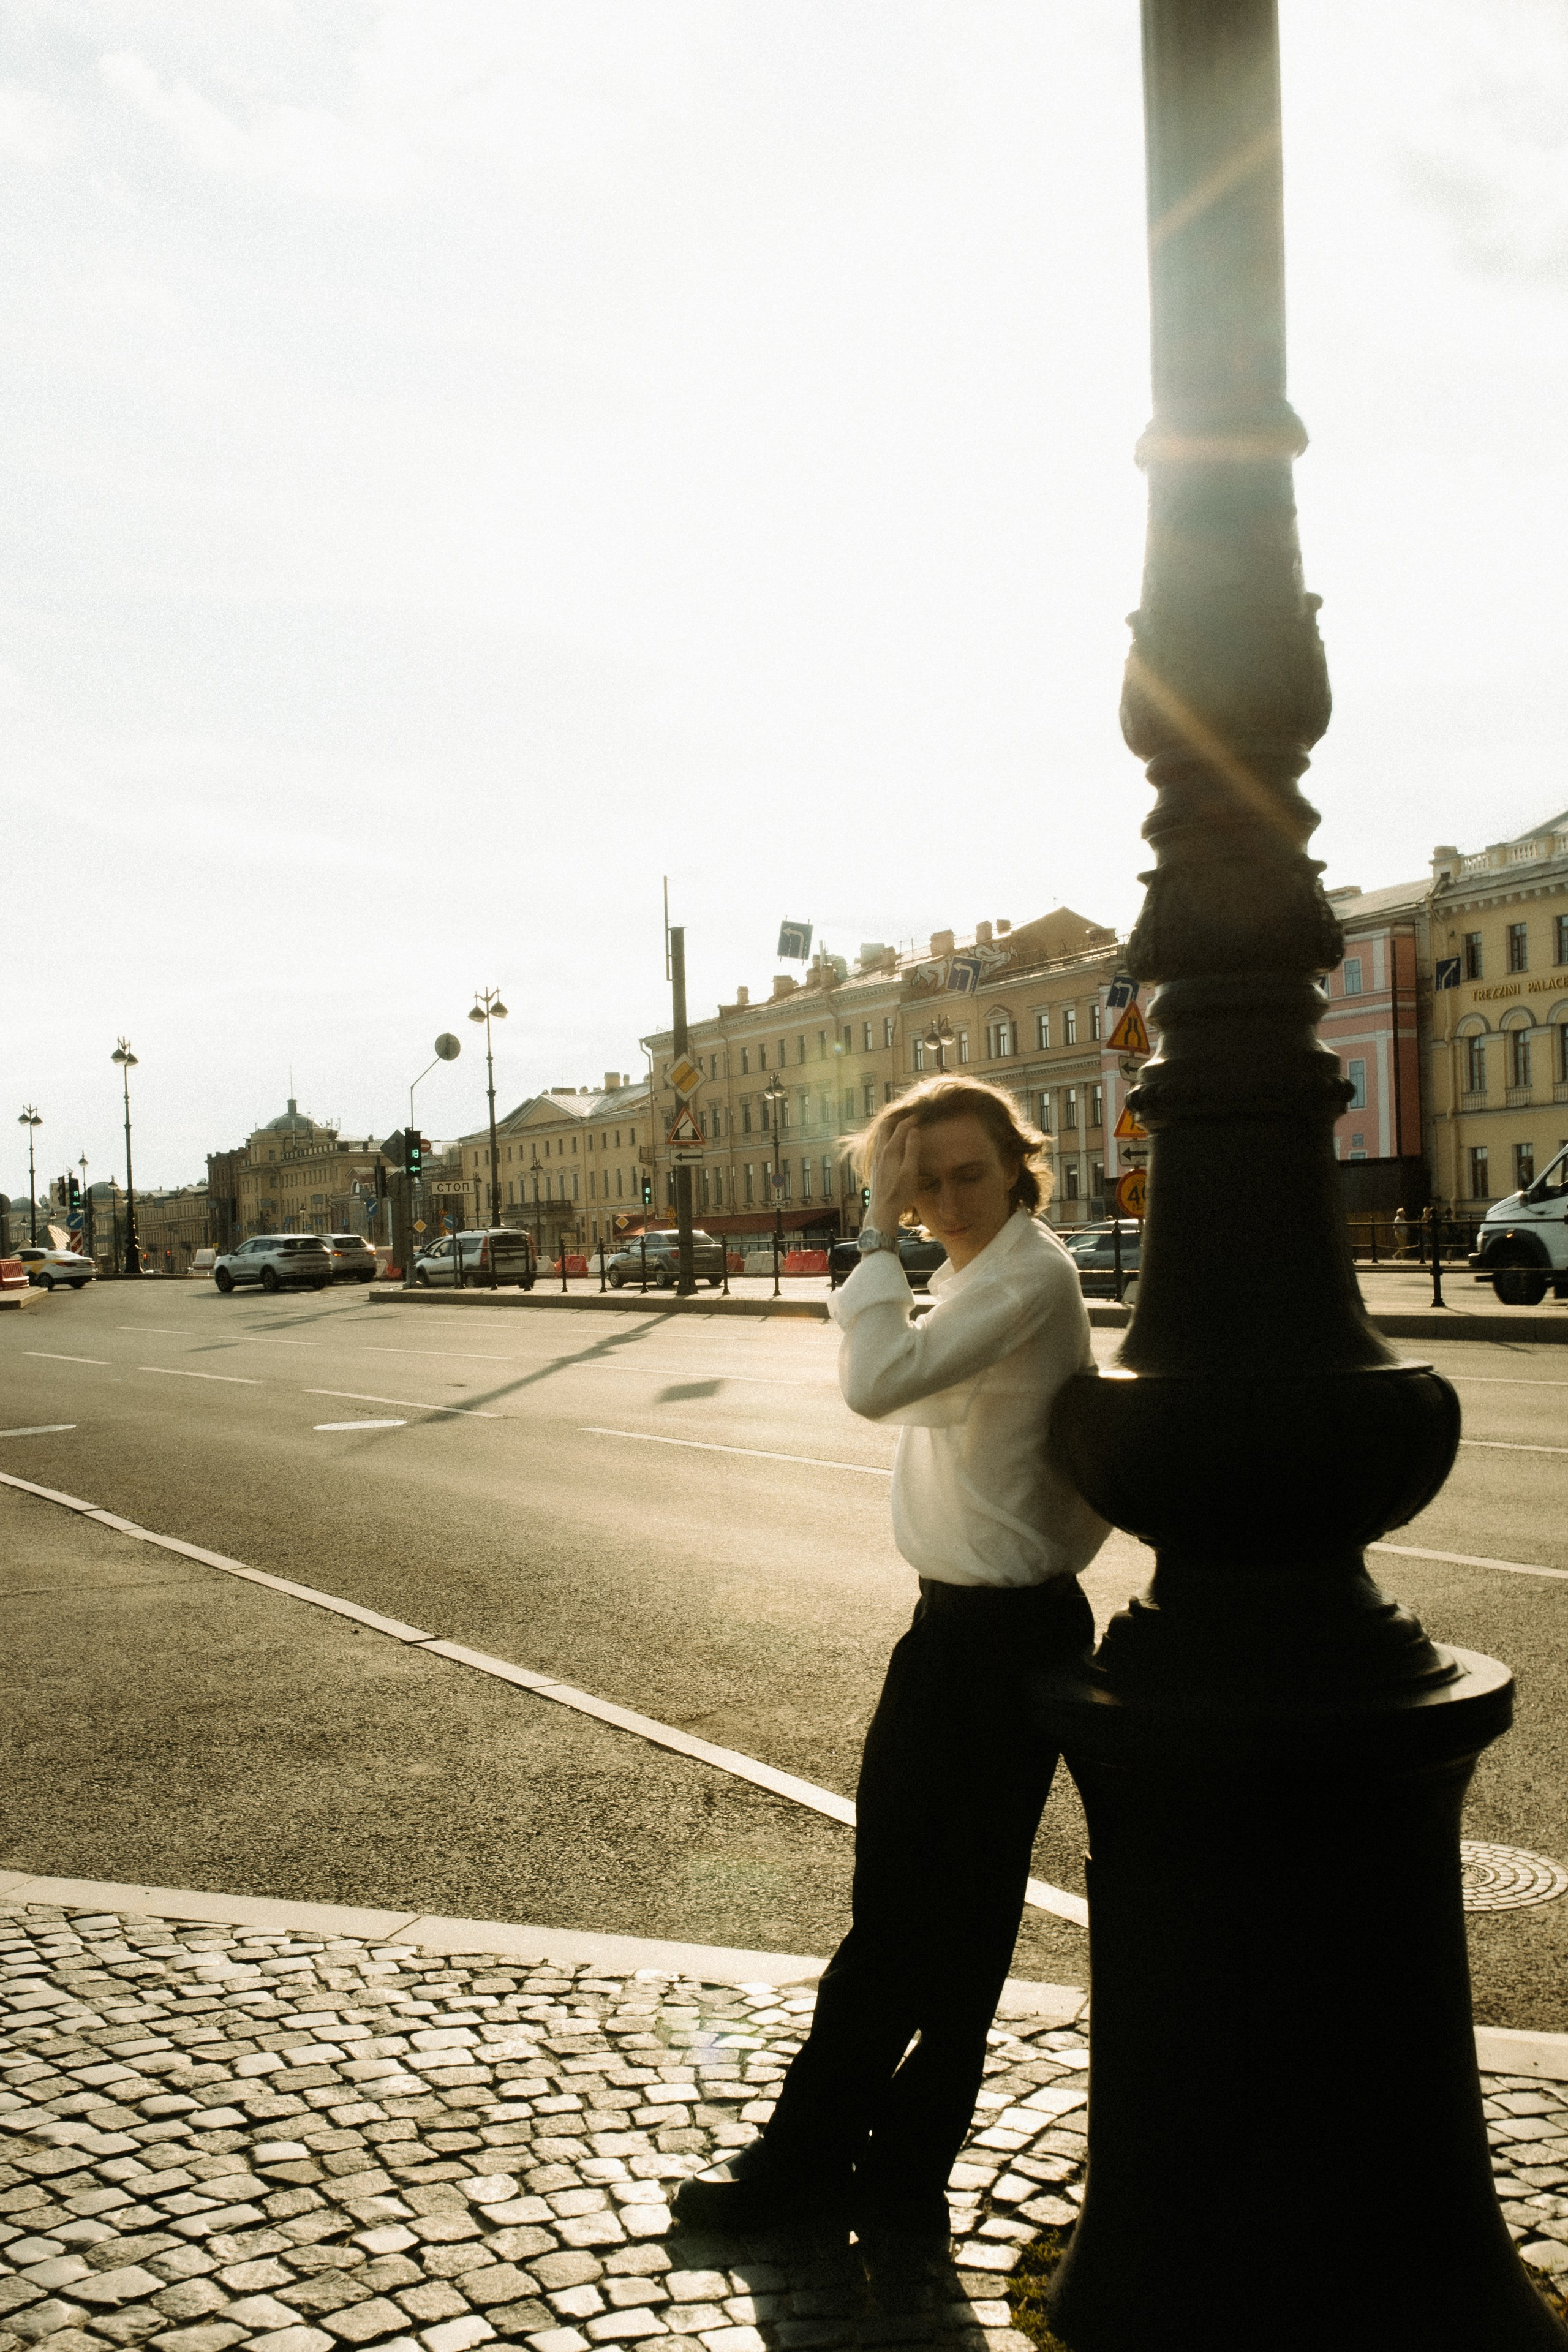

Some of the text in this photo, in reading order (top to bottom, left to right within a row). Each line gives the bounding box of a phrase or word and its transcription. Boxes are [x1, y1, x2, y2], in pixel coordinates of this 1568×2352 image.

[1471, 975, 1568, 1001] TREZZINI PALACE
[412, 1149, 419, 1158] 18
[437, 1183, 469, 1193] СТОП
